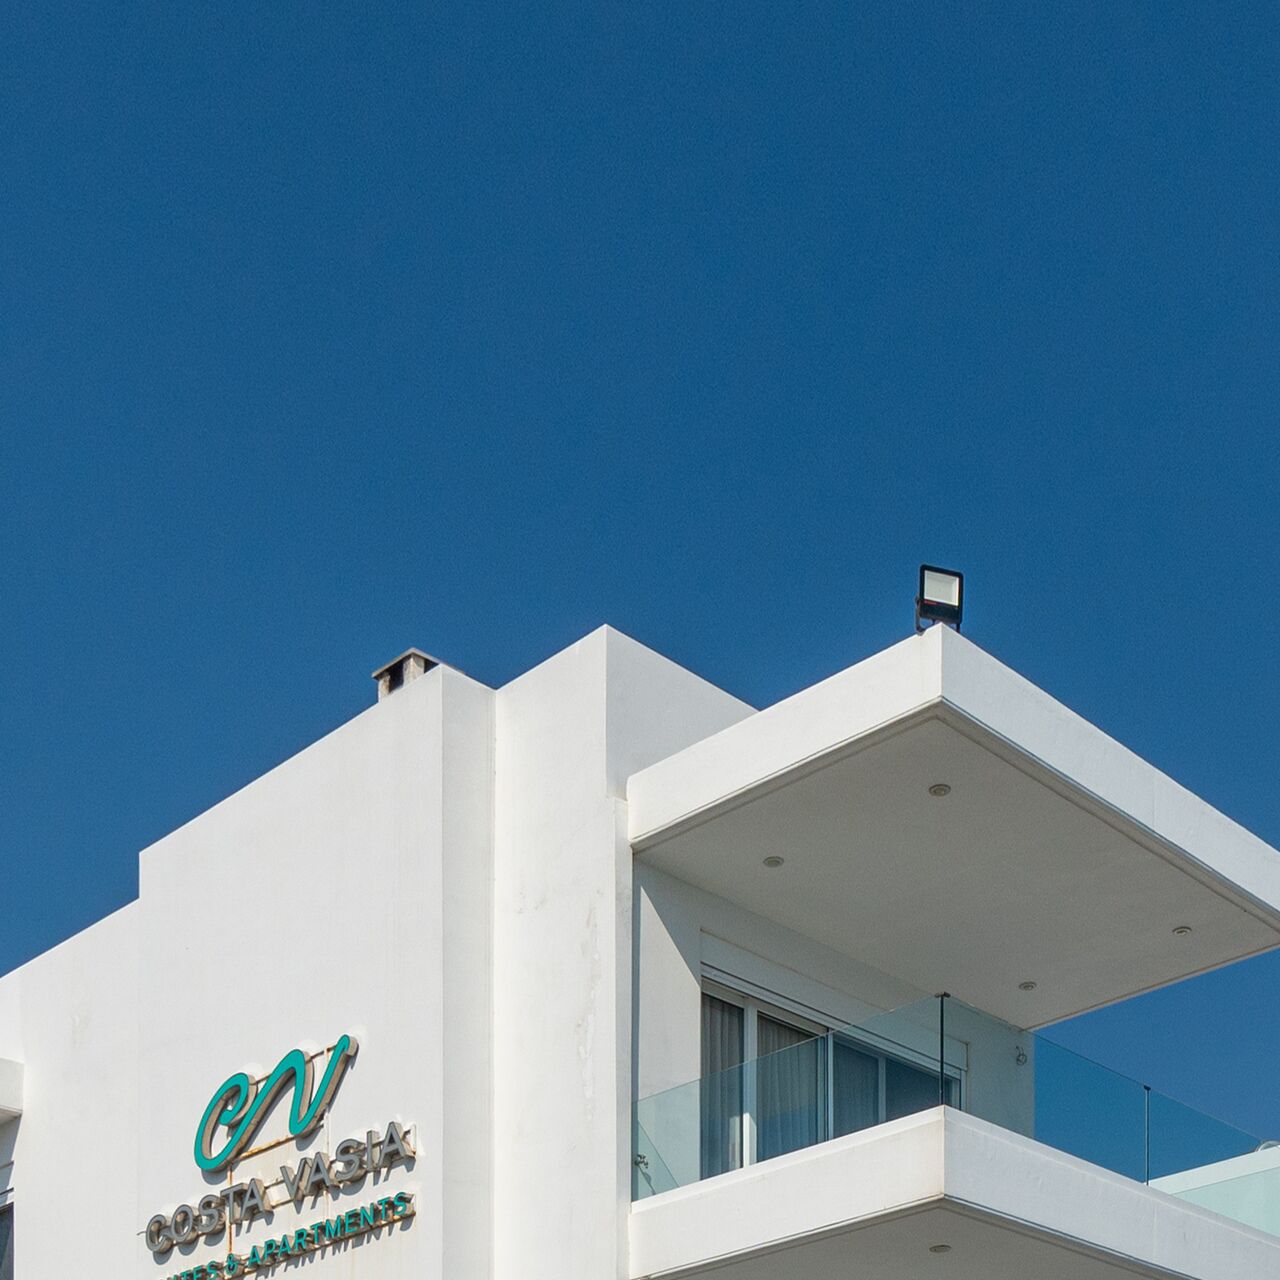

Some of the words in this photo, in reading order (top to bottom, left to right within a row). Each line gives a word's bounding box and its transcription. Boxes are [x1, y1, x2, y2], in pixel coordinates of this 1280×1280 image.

[145, 1178, 270, 1252] COSTA
[280, 1121, 413, 1200] VASIA
[225, 1253, 239, 1275] &
[247, 1192, 414, 1267] APARTMENTS
